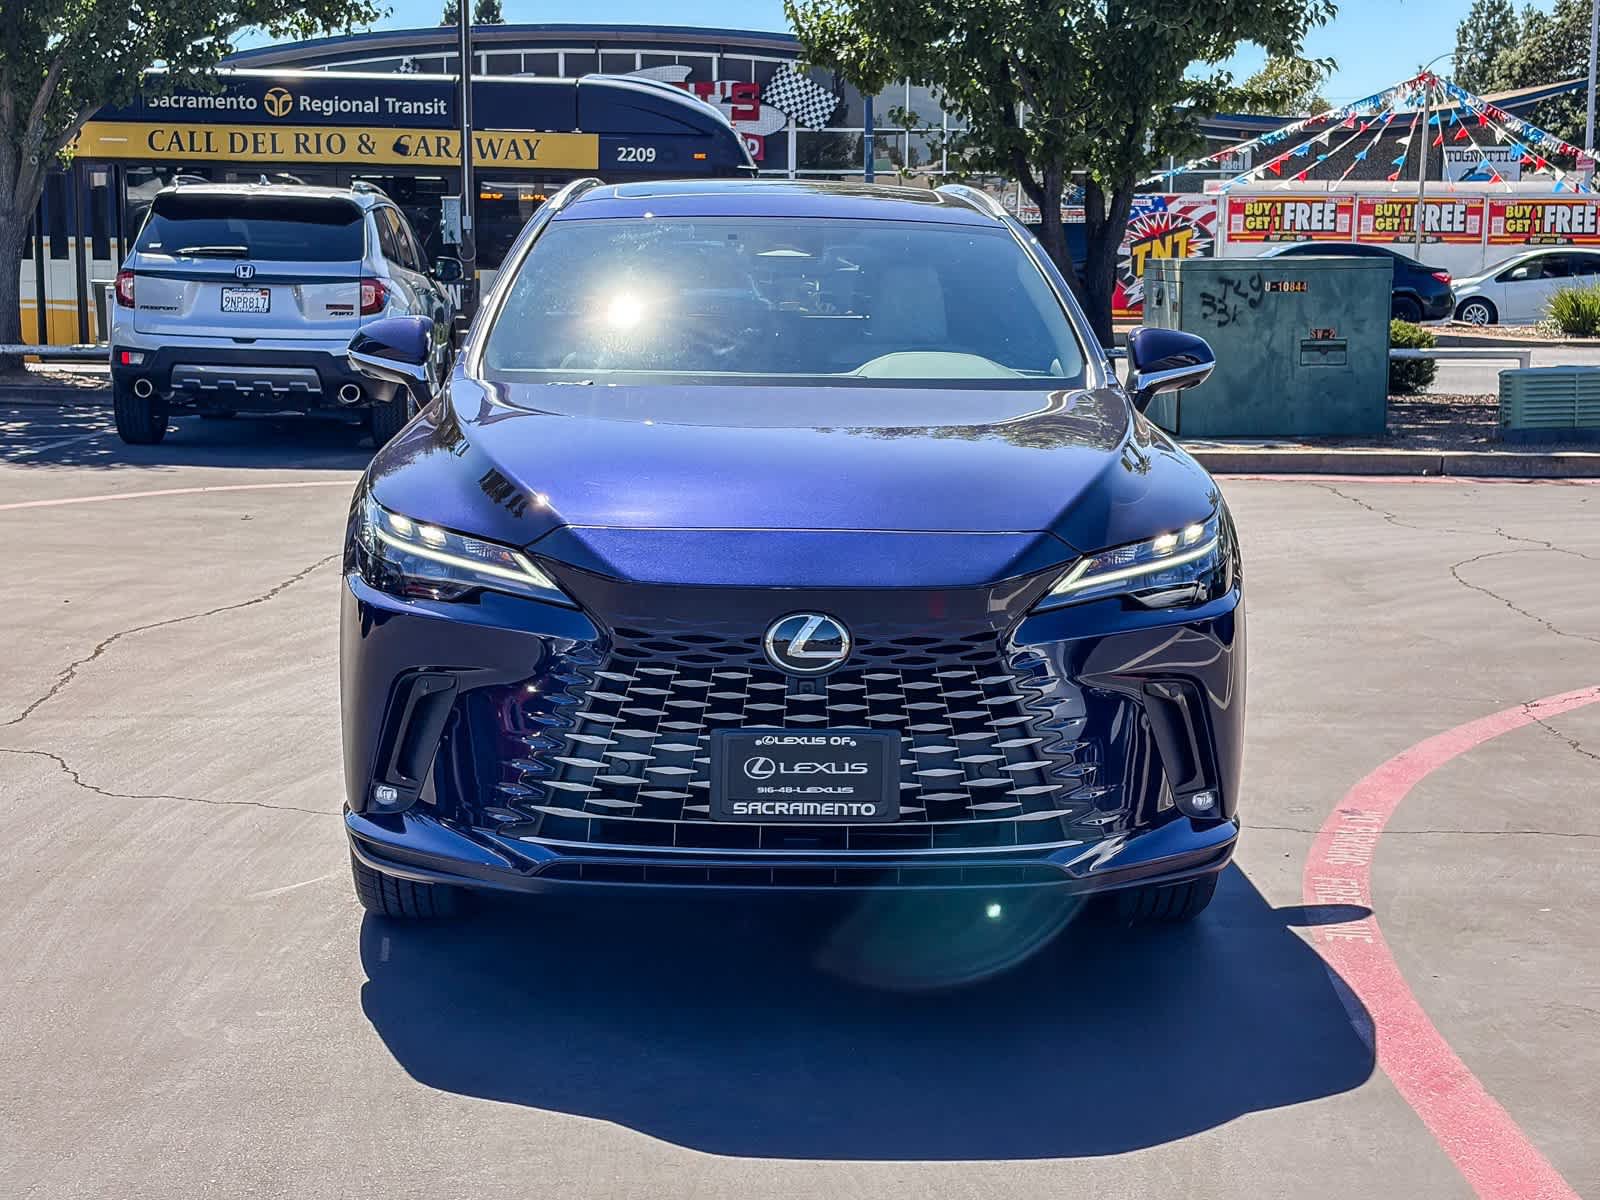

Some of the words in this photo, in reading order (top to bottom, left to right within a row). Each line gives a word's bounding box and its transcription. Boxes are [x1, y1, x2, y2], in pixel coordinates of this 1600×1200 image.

[300, 95, 379, 116] Regional
[385, 98, 447, 115] Transit
[147, 129, 219, 153] CALL
[229, 131, 284, 154] DEL
[294, 132, 347, 155] RIO
[356, 132, 377, 155] &
[392, 134, 541, 161] CARWAY
[616, 147, 656, 162] 2209
[1245, 202, 1273, 216] BUY
[1375, 204, 1402, 217] BUY
[1505, 205, 1532, 218] BUY
[1284, 202, 1337, 230] FREE
[1544, 205, 1597, 233] FREE
[1245, 217, 1271, 230] GET
[1375, 218, 1401, 231] GET
[1505, 219, 1531, 232] GET
[1131, 227, 1194, 278] TNT
[224, 296, 267, 309] 9NPR817
[775, 736, 826, 745] LEXUS
[830, 736, 850, 745] OF
[779, 762, 868, 774] LEXUS
[733, 801, 876, 816] SACRAMENTO
